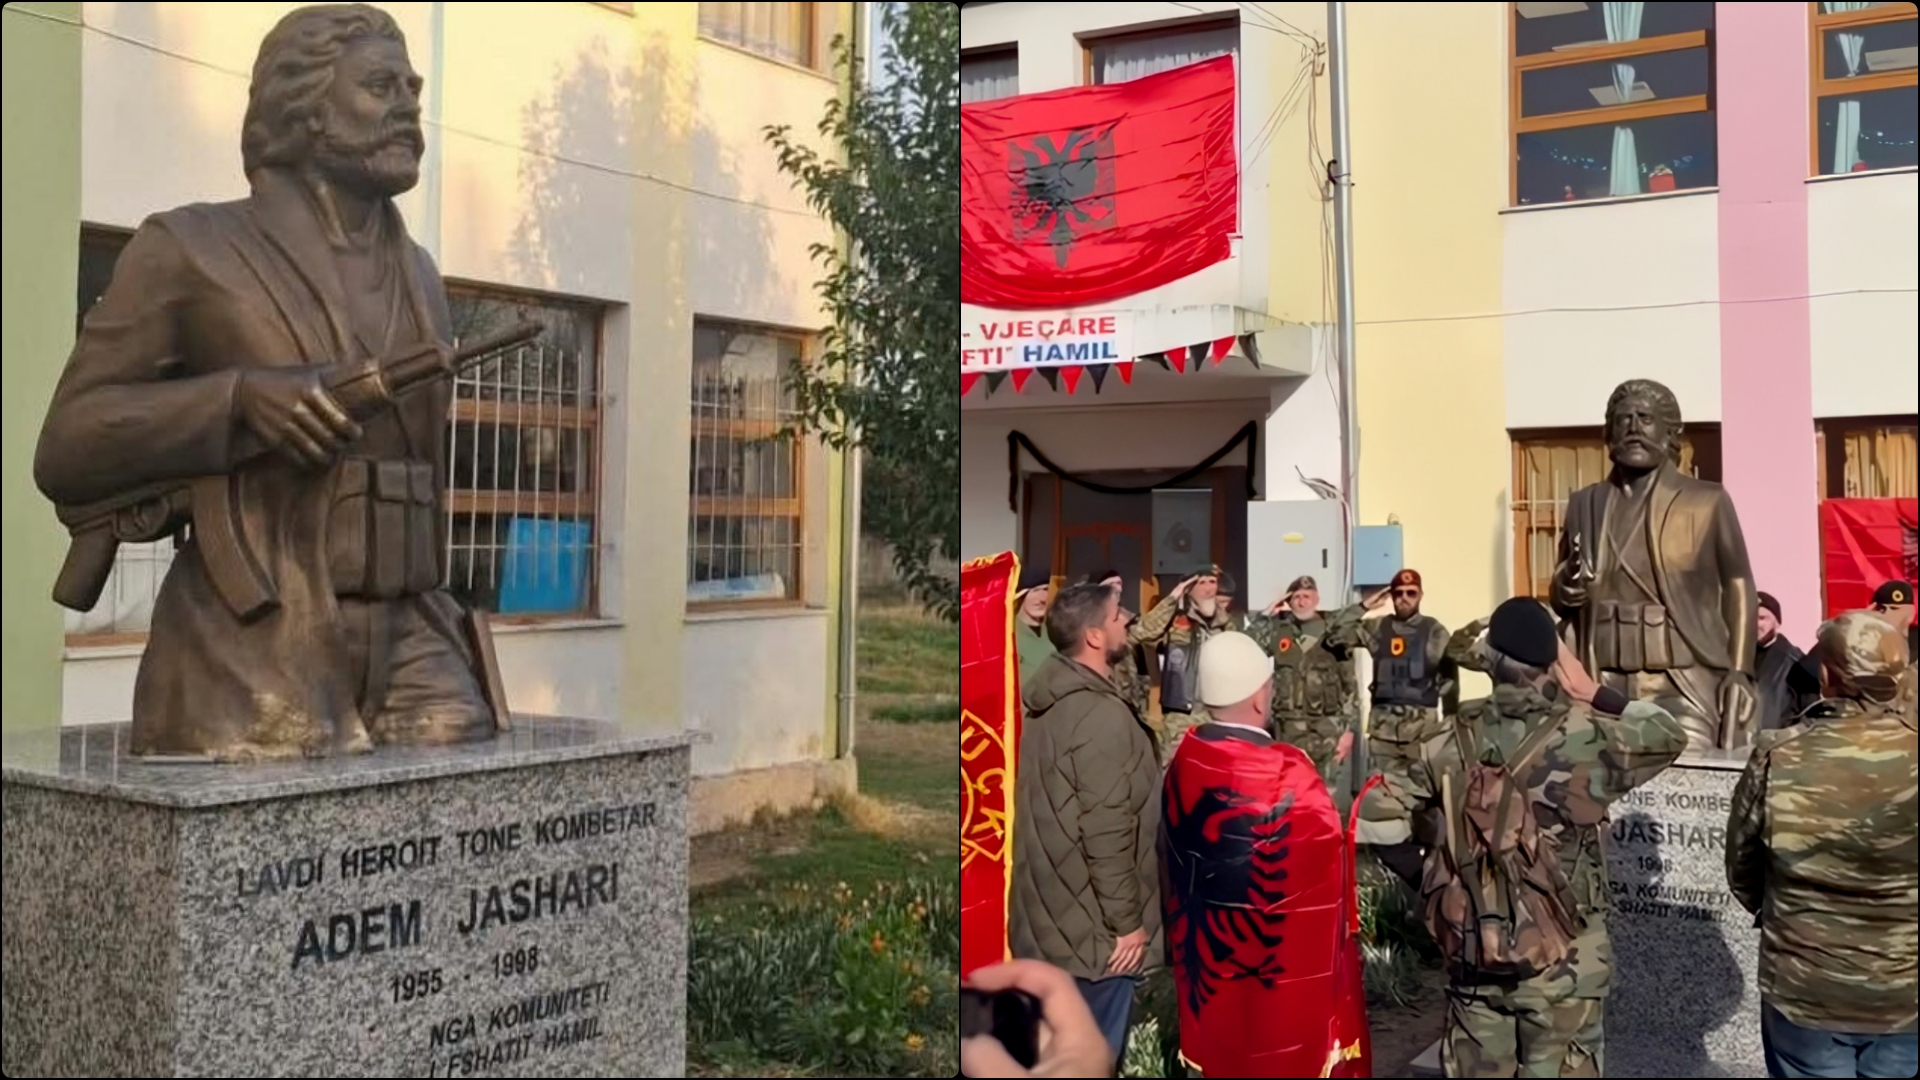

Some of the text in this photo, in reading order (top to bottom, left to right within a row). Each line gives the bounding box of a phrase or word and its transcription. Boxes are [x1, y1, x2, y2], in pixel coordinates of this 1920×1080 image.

[980, 316, 1116, 341] VJEÇARE
[1023, 341, 1118, 362] HAMIL
[238, 803, 657, 897] LAVDI HEROIT TONE KOMBETAR
[1612, 819, 1727, 850] JASHAR
[291, 862, 619, 970] ADEM JASHARI
[391, 968, 443, 1003] 1955
[492, 945, 539, 979] 1998
[430, 981, 610, 1048] NGA KOMUNITETI
[447, 1033, 534, 1079] FSHATIT
[543, 1017, 602, 1051] HAMIL
